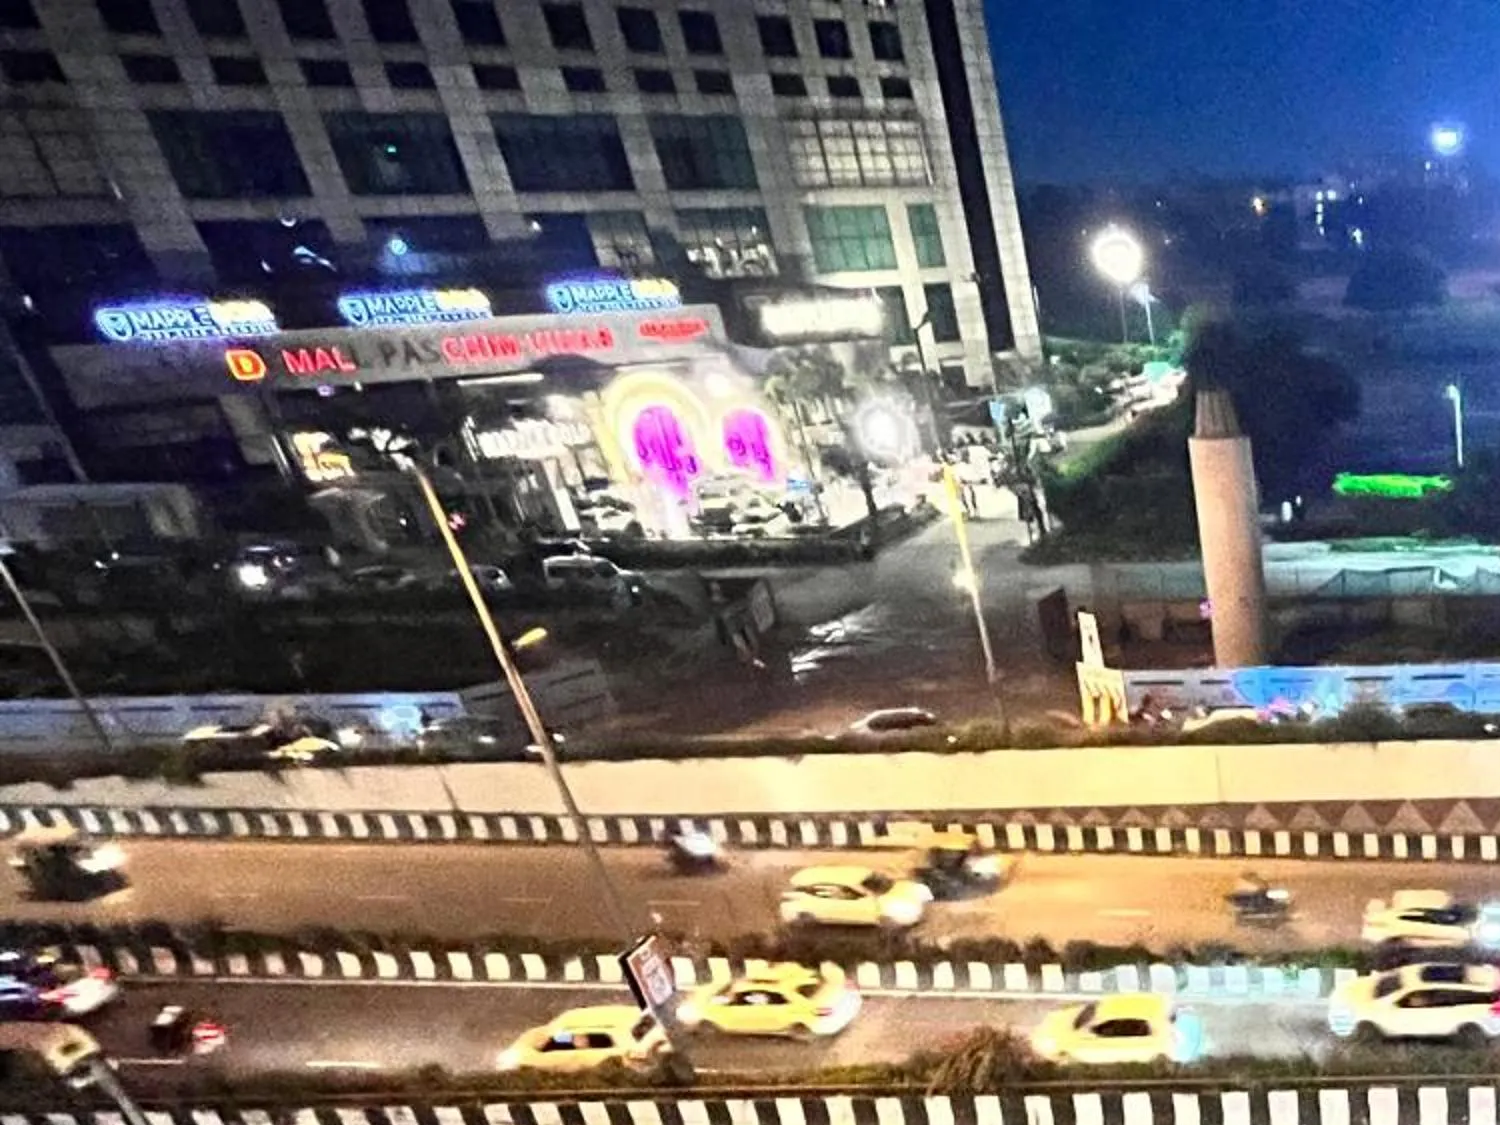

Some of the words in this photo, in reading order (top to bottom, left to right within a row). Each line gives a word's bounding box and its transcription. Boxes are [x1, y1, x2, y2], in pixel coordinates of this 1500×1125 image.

[569, 282, 632, 303] MAPPLE
[365, 294, 437, 315] MAPPLE
[127, 307, 211, 329] MAPPLE
